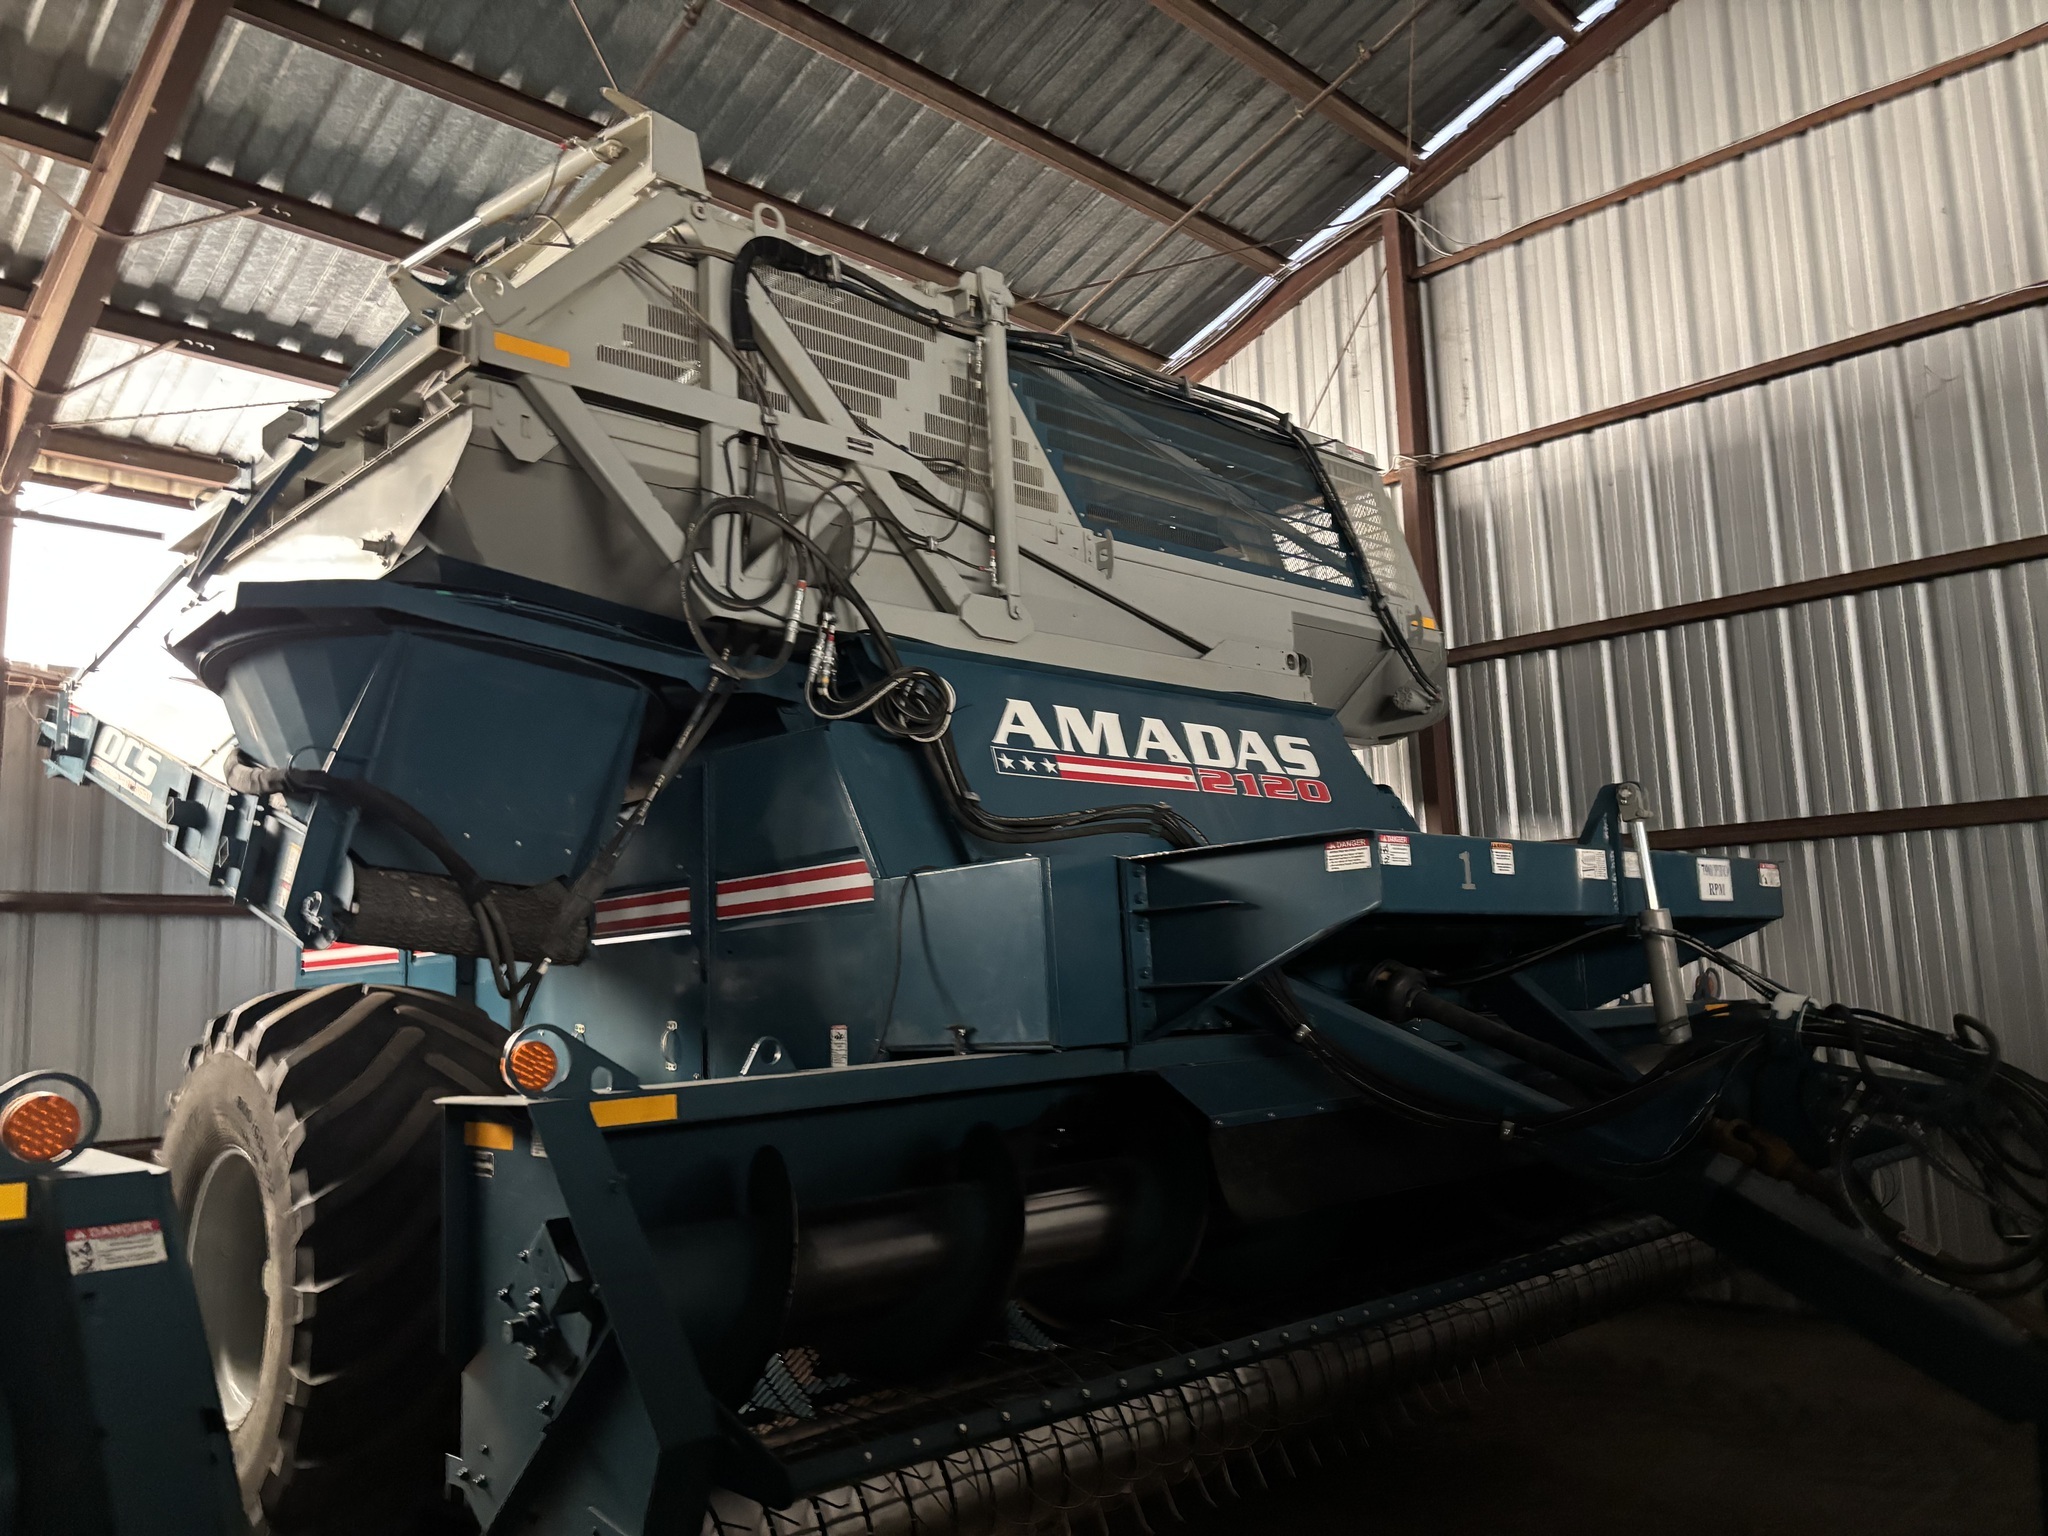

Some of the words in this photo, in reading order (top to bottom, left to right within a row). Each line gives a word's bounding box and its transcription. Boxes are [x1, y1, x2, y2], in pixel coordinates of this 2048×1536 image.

[991, 697, 1320, 777] AMADAS
[1196, 767, 1332, 803] 2120
[1336, 839, 1366, 848] DANGER
[1458, 850, 1476, 890] 1
[1708, 882, 1726, 896] RPM
